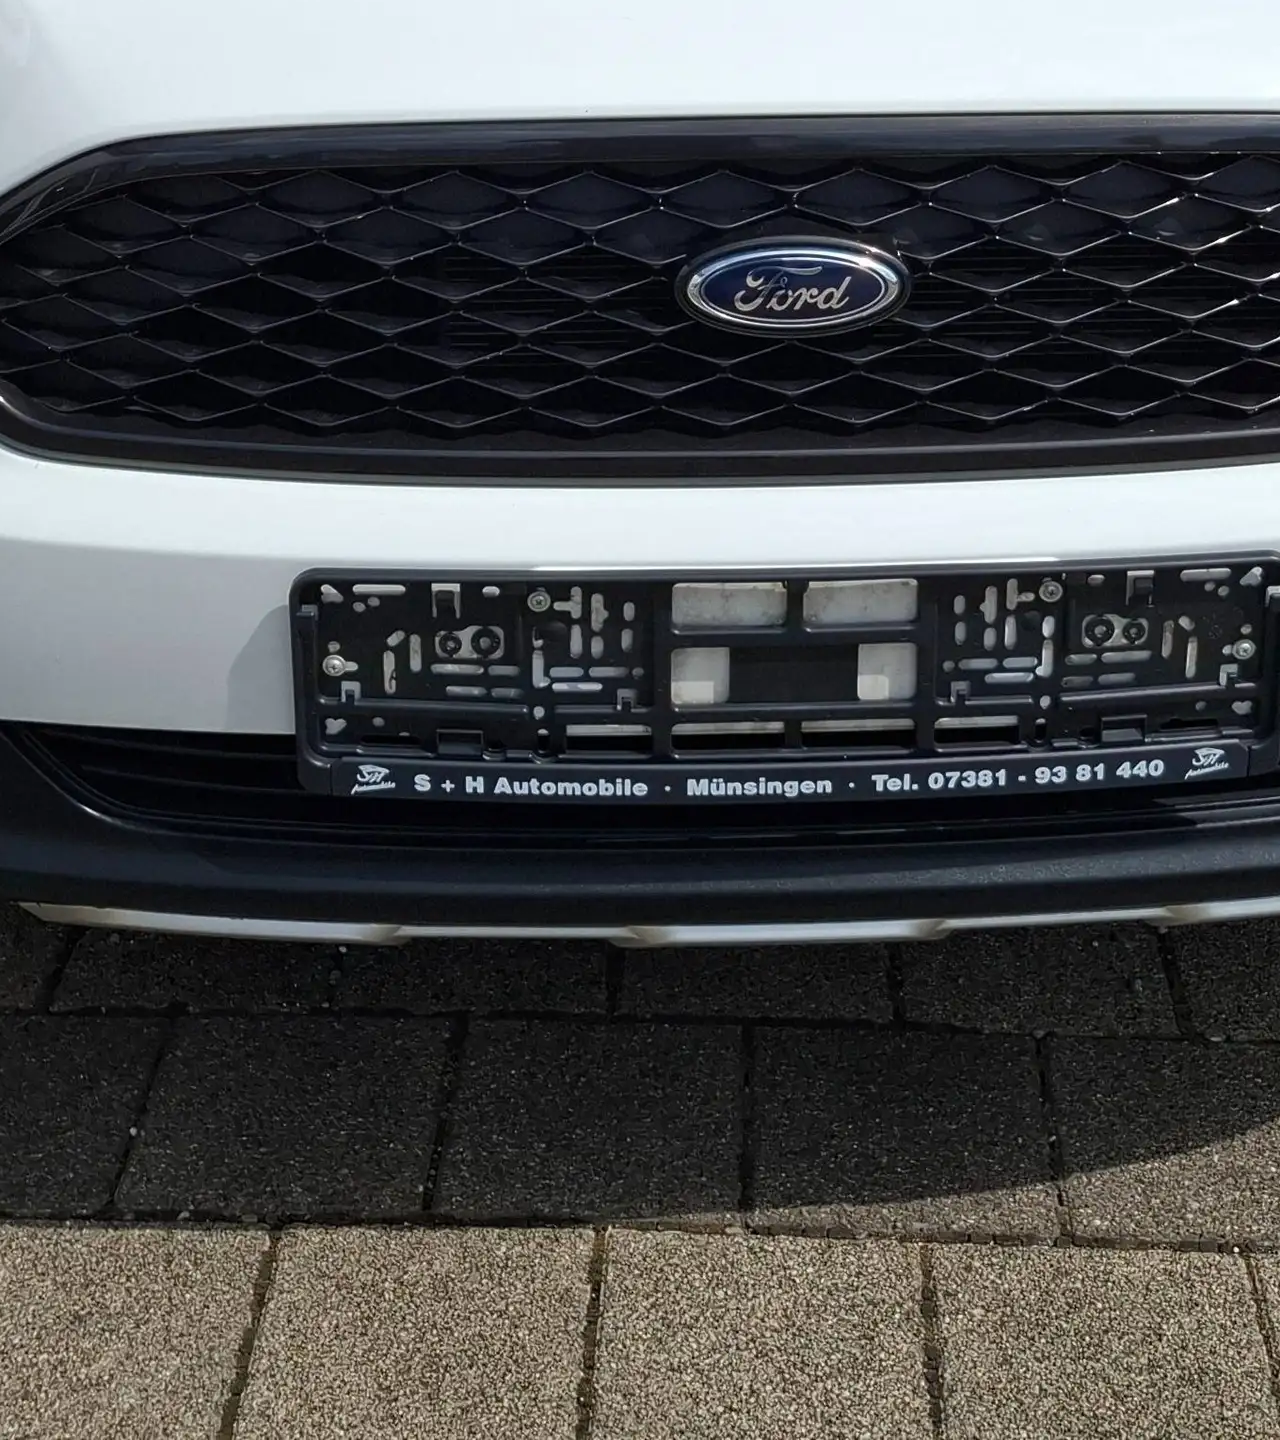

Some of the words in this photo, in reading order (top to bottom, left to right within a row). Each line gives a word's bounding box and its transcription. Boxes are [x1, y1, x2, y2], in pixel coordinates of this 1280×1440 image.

[734, 266, 851, 310] Ford
[414, 774, 431, 791] S
[441, 779, 455, 793] +
[465, 776, 484, 793] H
[493, 776, 648, 796] Automobile
[686, 777, 832, 797] Münsingen
[871, 773, 919, 791] Tel.
[928, 769, 1007, 789] 07381
[1035, 766, 1067, 784] 93
[1076, 763, 1105, 782] 81
[1116, 759, 1164, 777] 440
